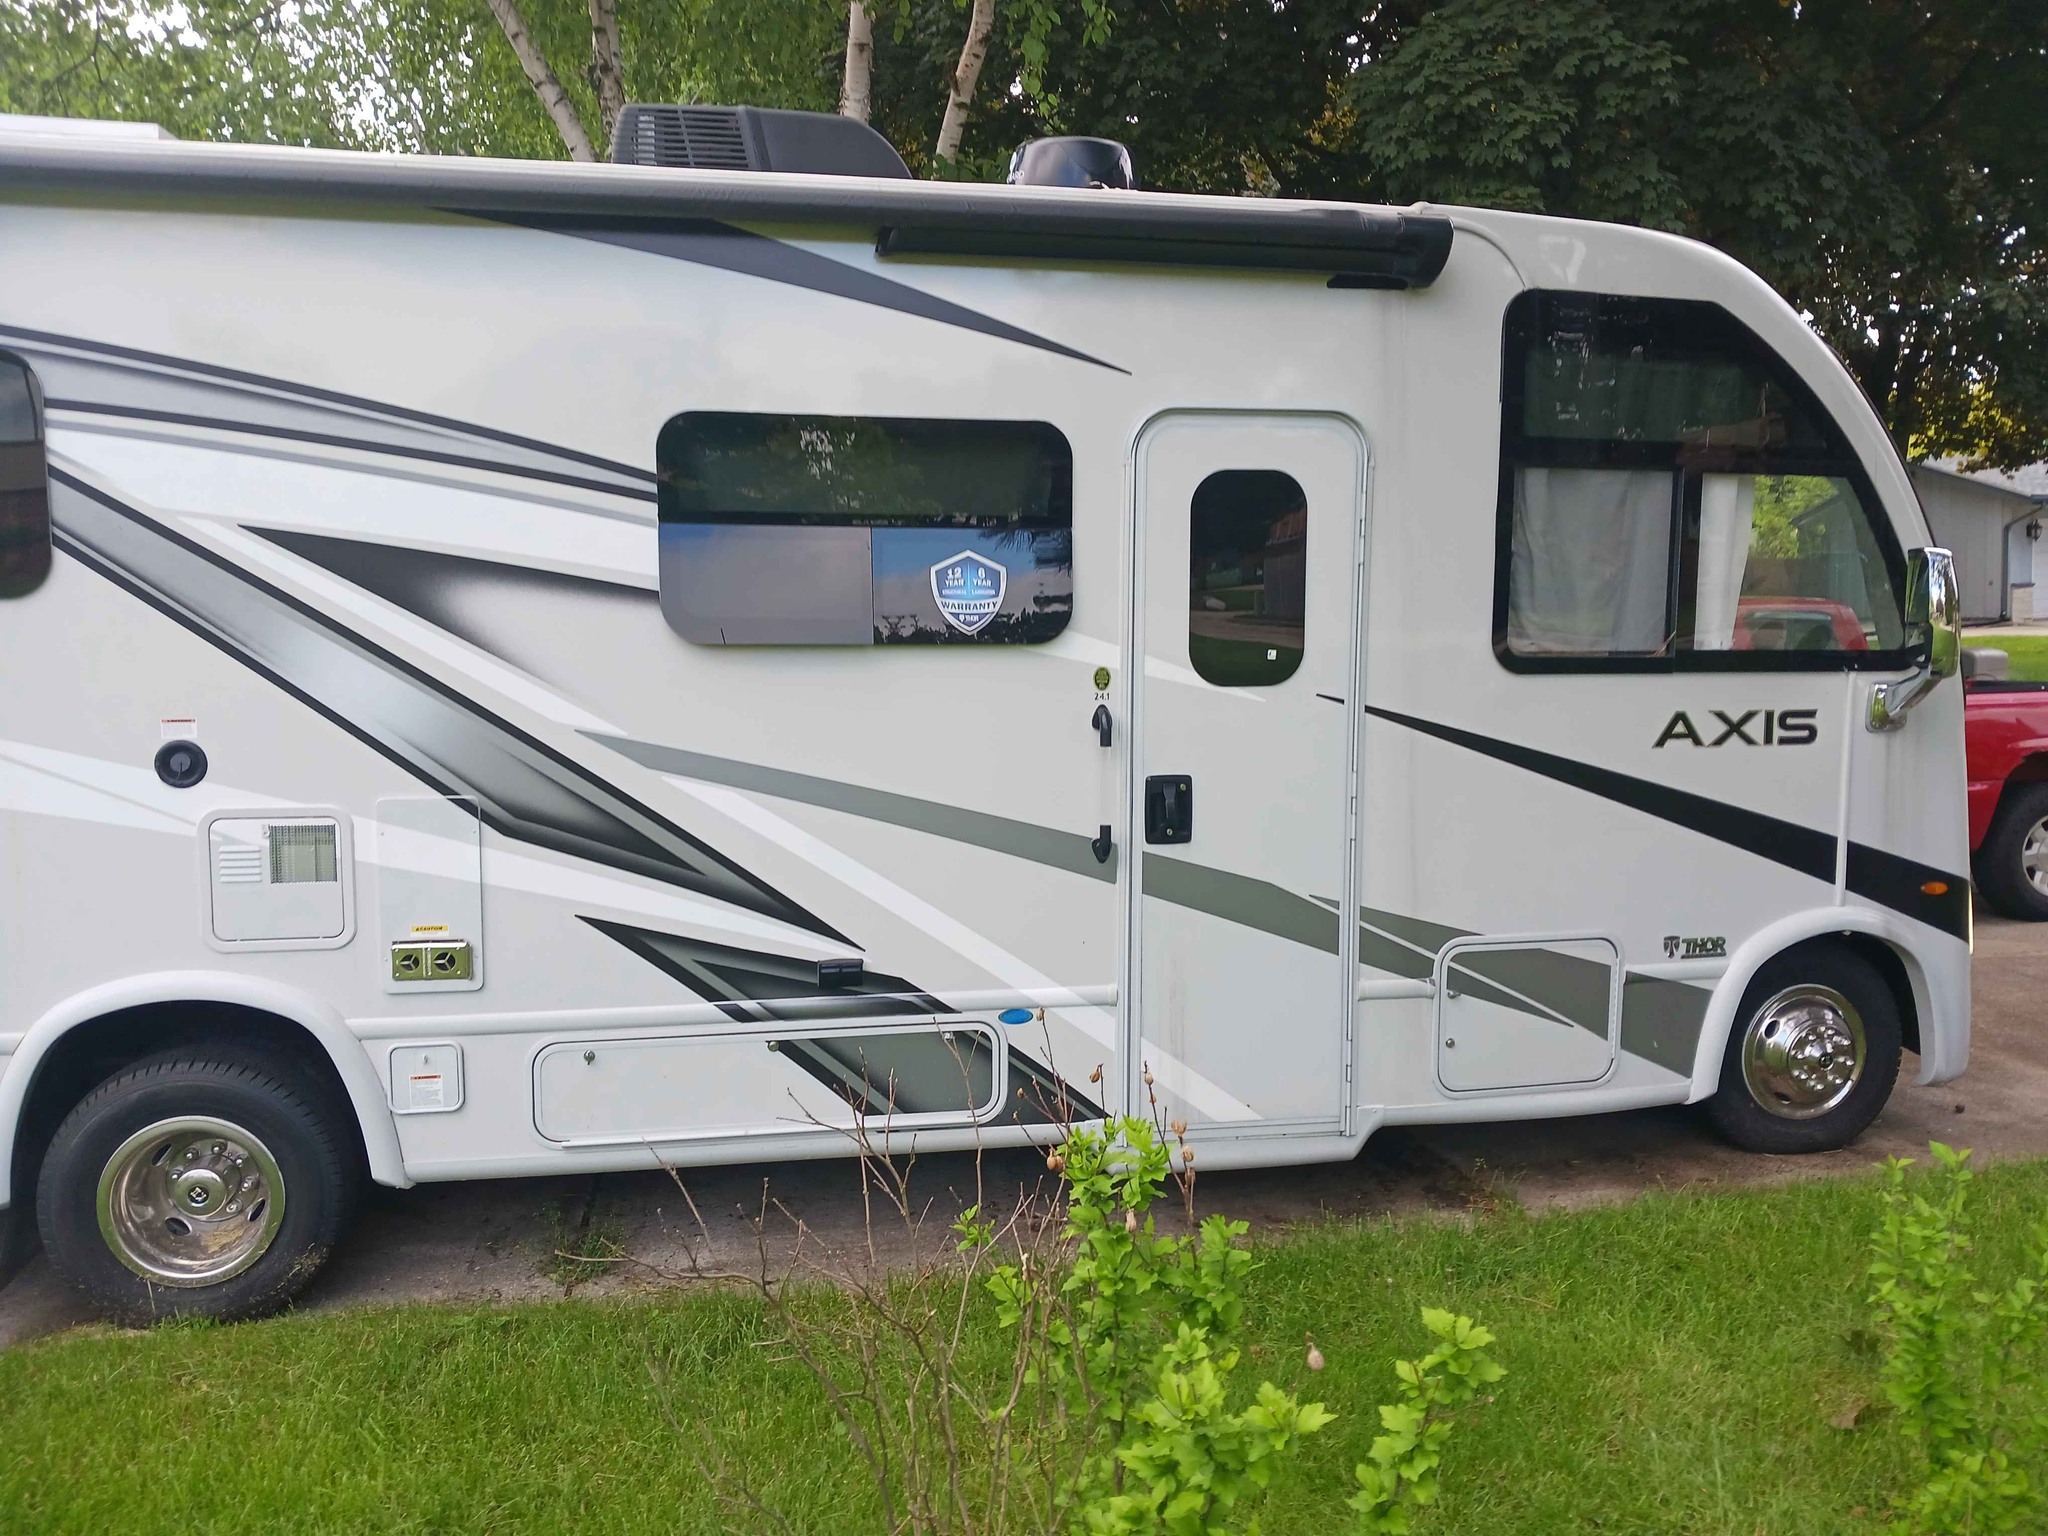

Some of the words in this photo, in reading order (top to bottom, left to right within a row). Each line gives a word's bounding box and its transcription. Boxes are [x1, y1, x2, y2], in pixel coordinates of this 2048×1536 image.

[947, 567, 962, 578] 12
[941, 600, 998, 610] WARRANTY
[1094, 692, 1110, 701] 24.1
[1652, 708, 1818, 749] AXIS
[1681, 936, 1727, 957] THOR
